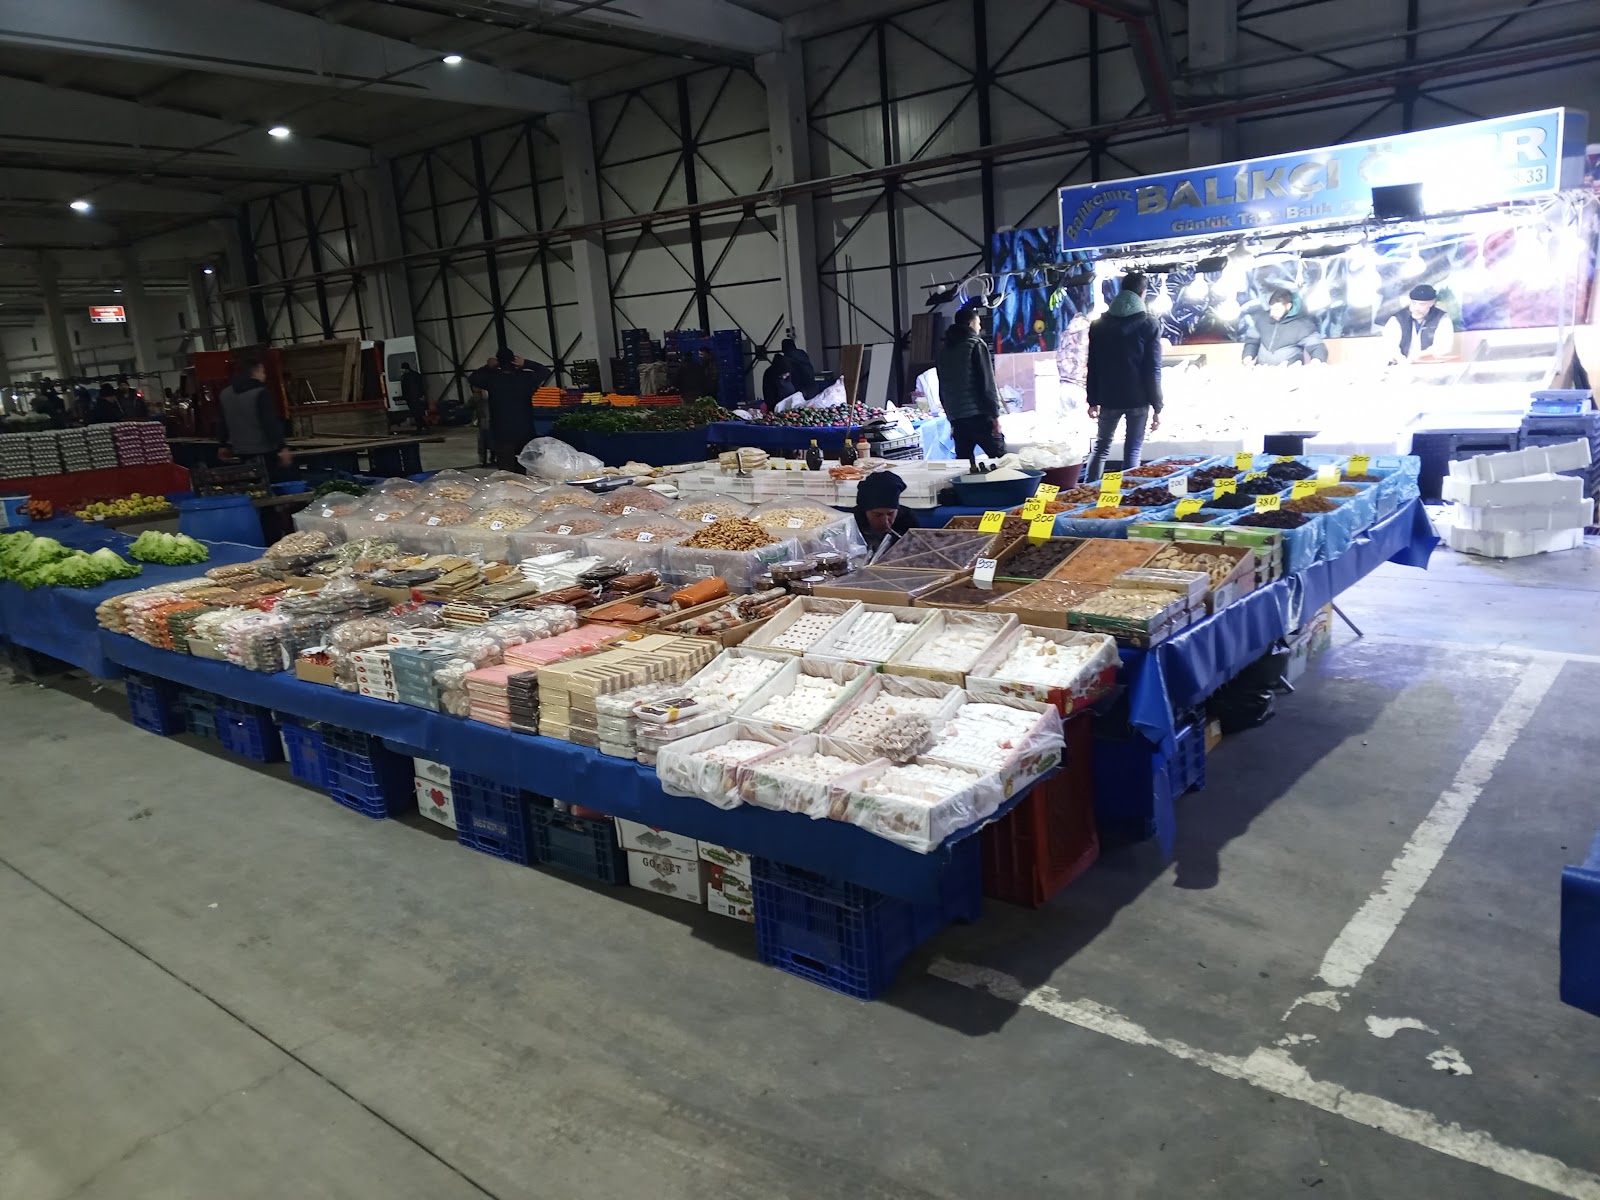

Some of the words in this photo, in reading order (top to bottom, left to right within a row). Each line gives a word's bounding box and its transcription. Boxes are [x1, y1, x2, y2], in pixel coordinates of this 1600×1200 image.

[1171, 214, 1232, 232] Günlük
[1039, 484, 1058, 494] 380
[1215, 480, 1236, 488] 300
[1257, 496, 1278, 507] 380
[1033, 513, 1054, 523] 800
